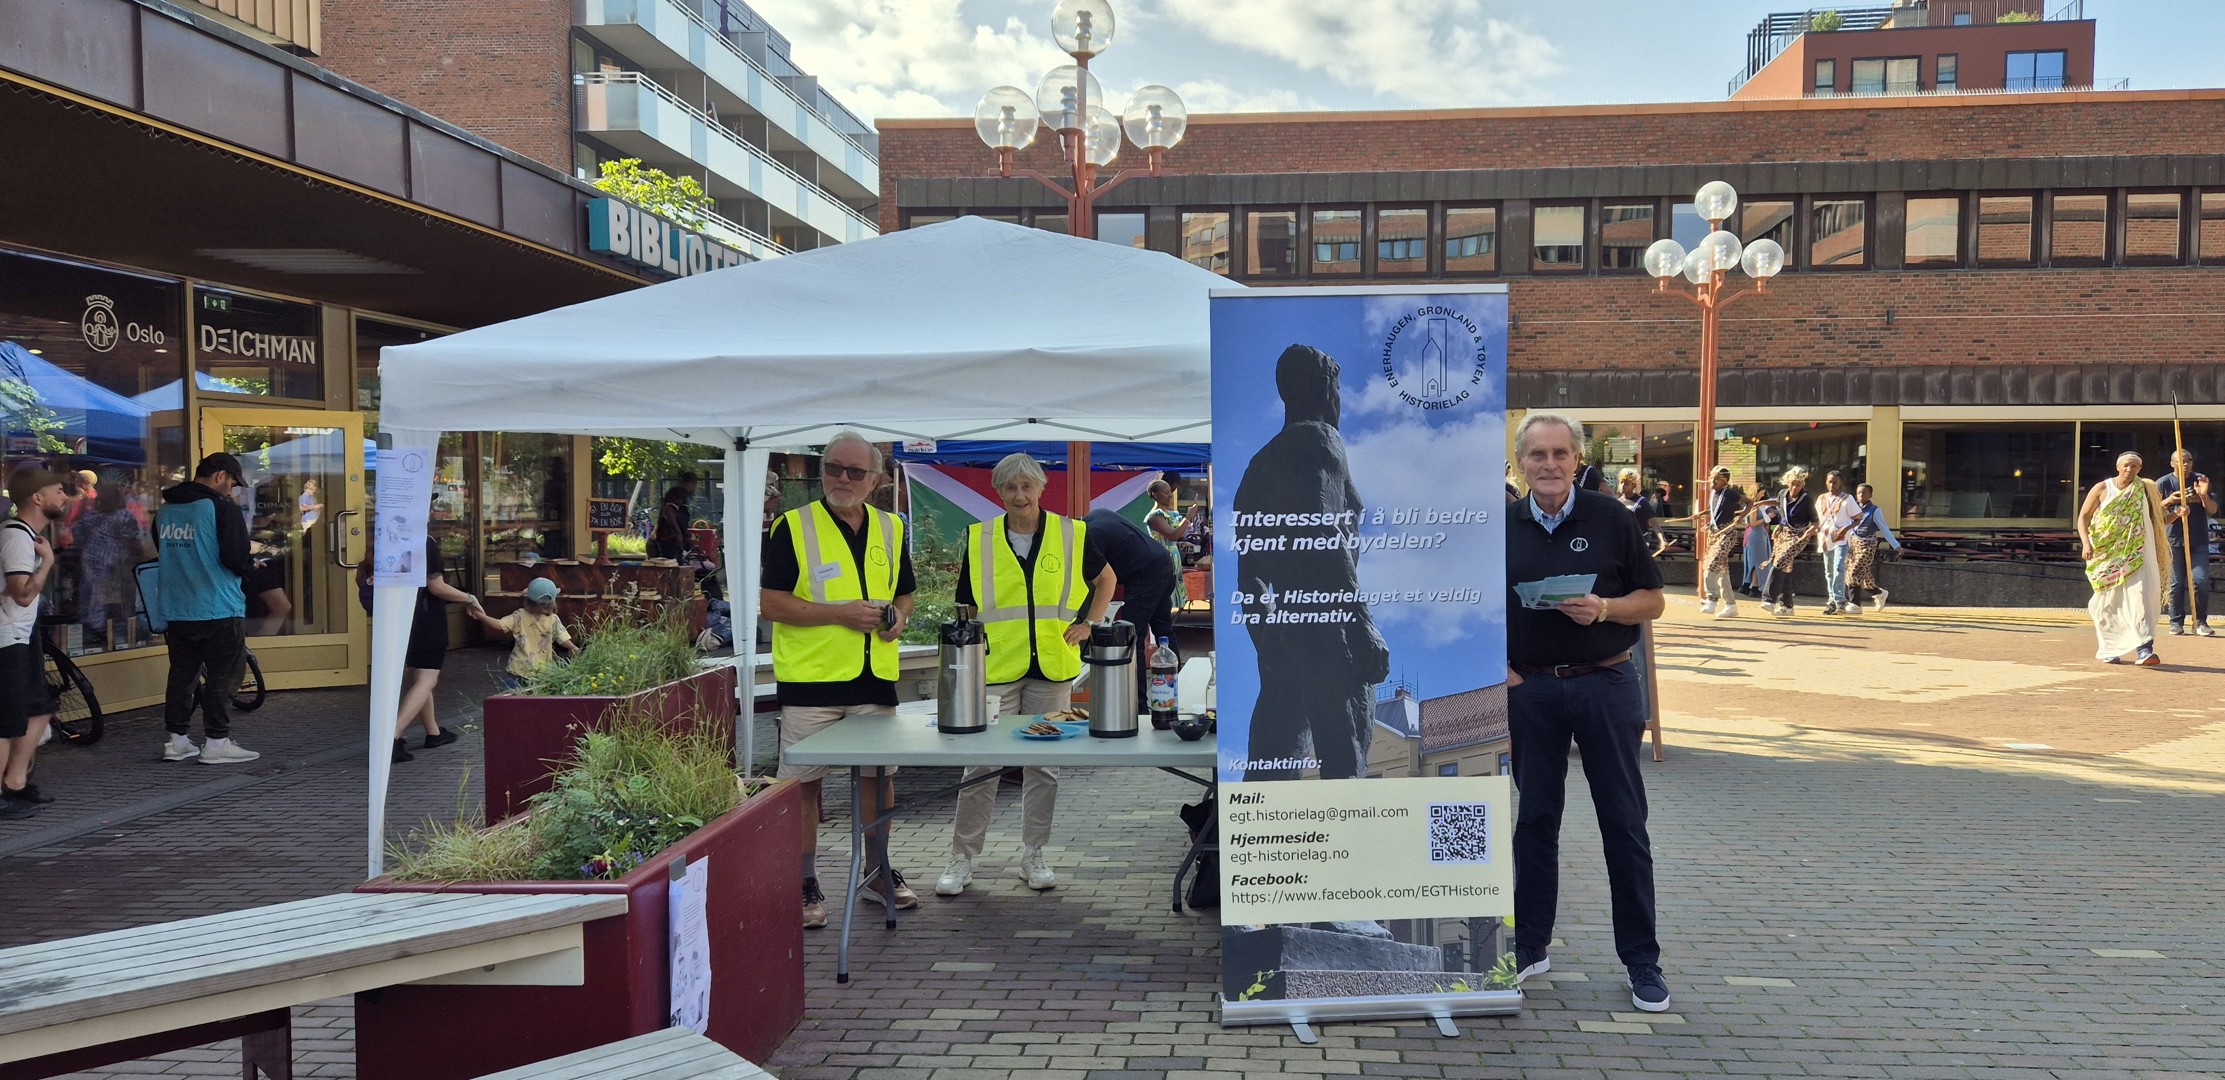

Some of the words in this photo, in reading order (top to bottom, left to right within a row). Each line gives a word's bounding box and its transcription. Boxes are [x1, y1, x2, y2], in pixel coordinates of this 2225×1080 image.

[1417, 306, 1477, 334] GRØNLAND
[127, 322, 165, 345] Oslo
[1473, 335, 1483, 344] &
[200, 324, 316, 365] DEICHMAN
[1382, 313, 1417, 388] ENERHAUGEN,
[1471, 345, 1486, 385] TØYEN
[1398, 390, 1470, 410] HISTORIELAG
[1228, 509, 1354, 528] Interessert
[1359, 509, 1368, 525] i
[1371, 507, 1386, 526] å
[1391, 507, 1421, 526] bli
[1425, 507, 1489, 525] bedre
[160, 523, 196, 540] Wolt
[1230, 534, 1288, 555] kjent
[1292, 533, 1342, 551] med
[1346, 532, 1448, 554] bydelen?
[1230, 591, 1255, 605] Da
[1259, 592, 1280, 605] er
[1283, 589, 1400, 606] Historielaget
[1403, 588, 1424, 603] et
[1427, 587, 1483, 605] veldig
[1231, 611, 1261, 625] bra
[1265, 609, 1358, 625] alternativ.
[1228, 756, 1323, 772] Kontaktinfo:
[1229, 792, 1266, 805] Mail:
[1229, 806, 1409, 825] egt.historielag@gmail.com
[1230, 831, 1330, 848] Hjemmeside:
[1230, 848, 1350, 866] egt-historielag.no
[1231, 872, 1309, 887] Facebook:
[1231, 884, 1500, 906] https://www.facebook.com/EGTHistorie
